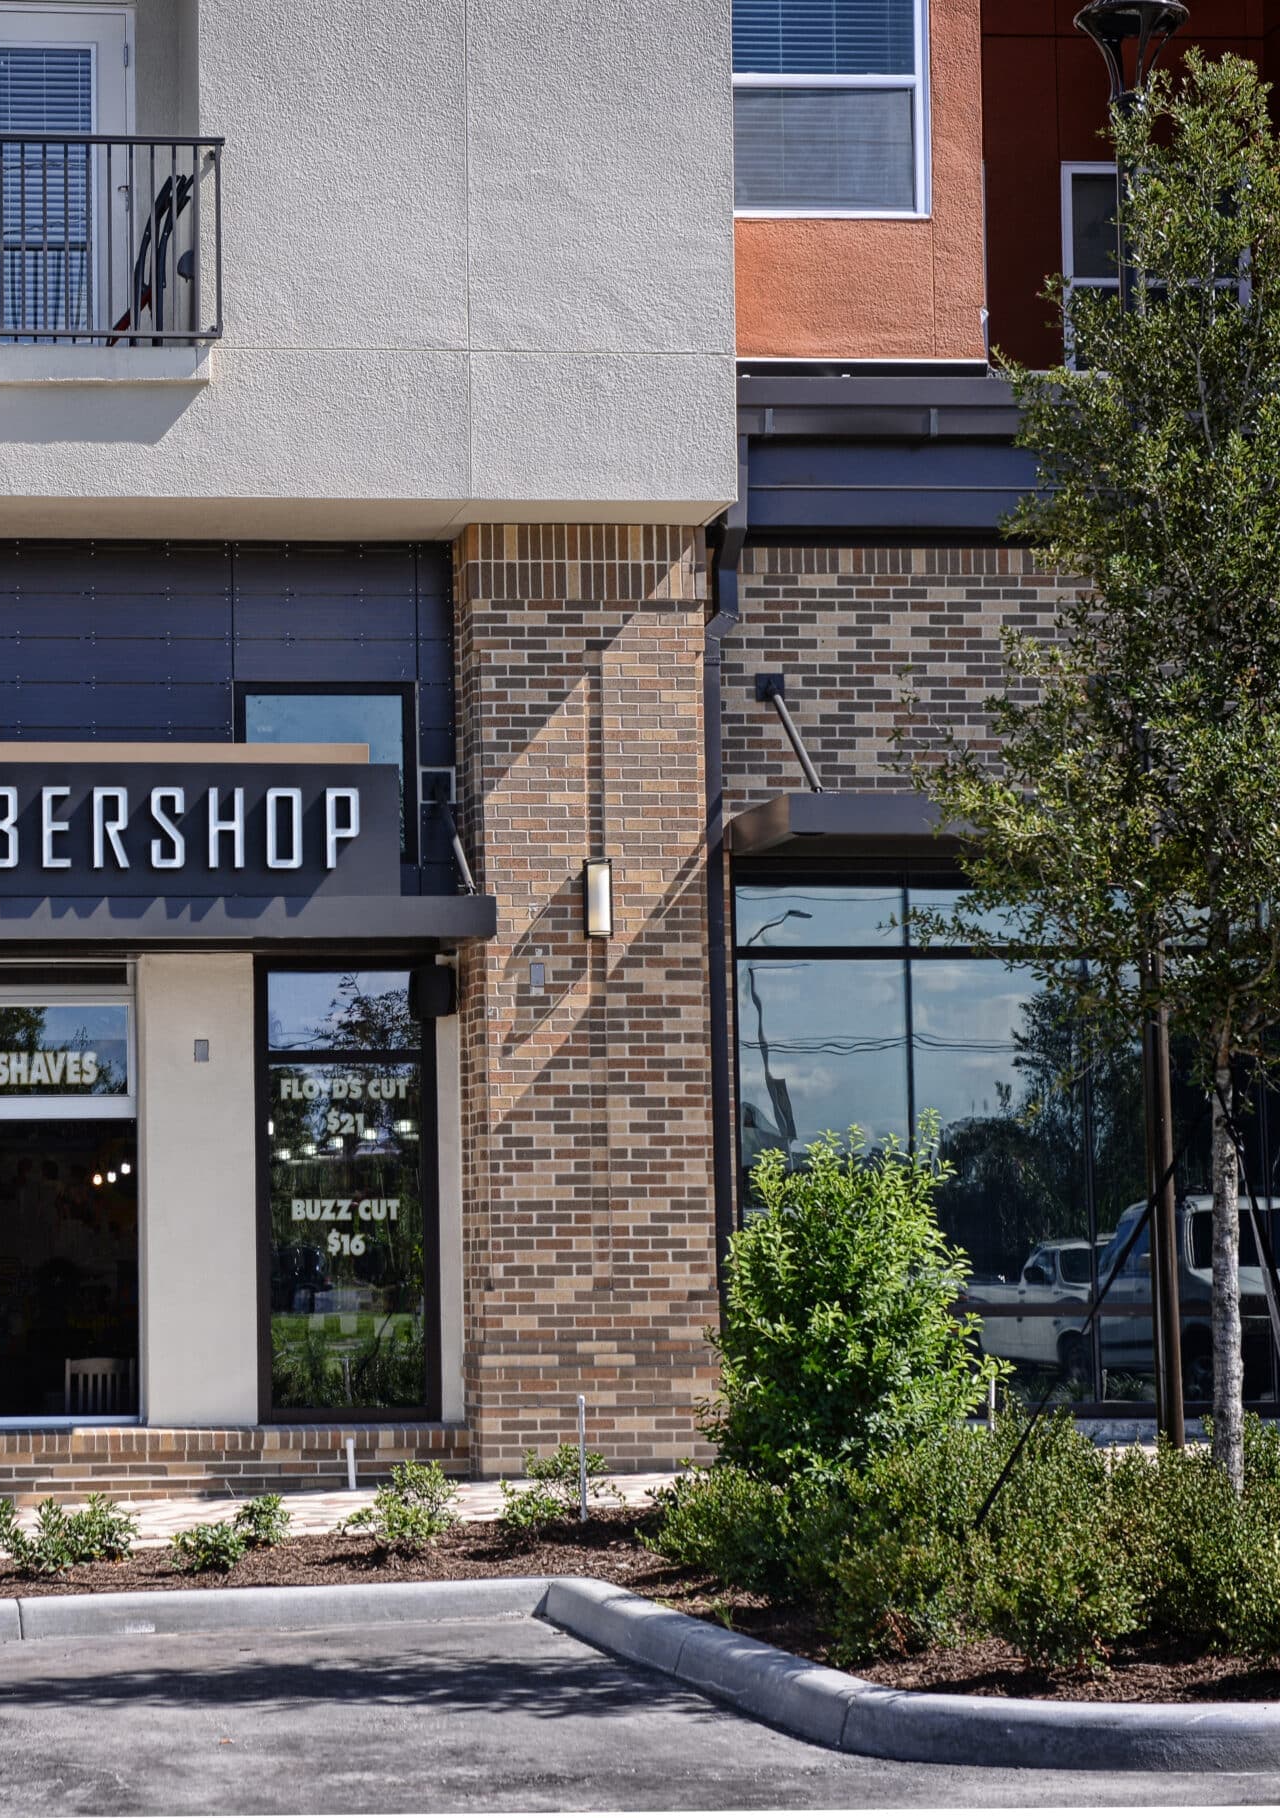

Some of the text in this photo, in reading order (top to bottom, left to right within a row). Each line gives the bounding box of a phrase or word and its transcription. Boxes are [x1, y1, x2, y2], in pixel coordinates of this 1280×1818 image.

[367, 1079, 410, 1100] CUT
[326, 1107, 365, 1135] $21
[291, 1199, 401, 1221] BUZZ CUT
[326, 1228, 367, 1257] $16
